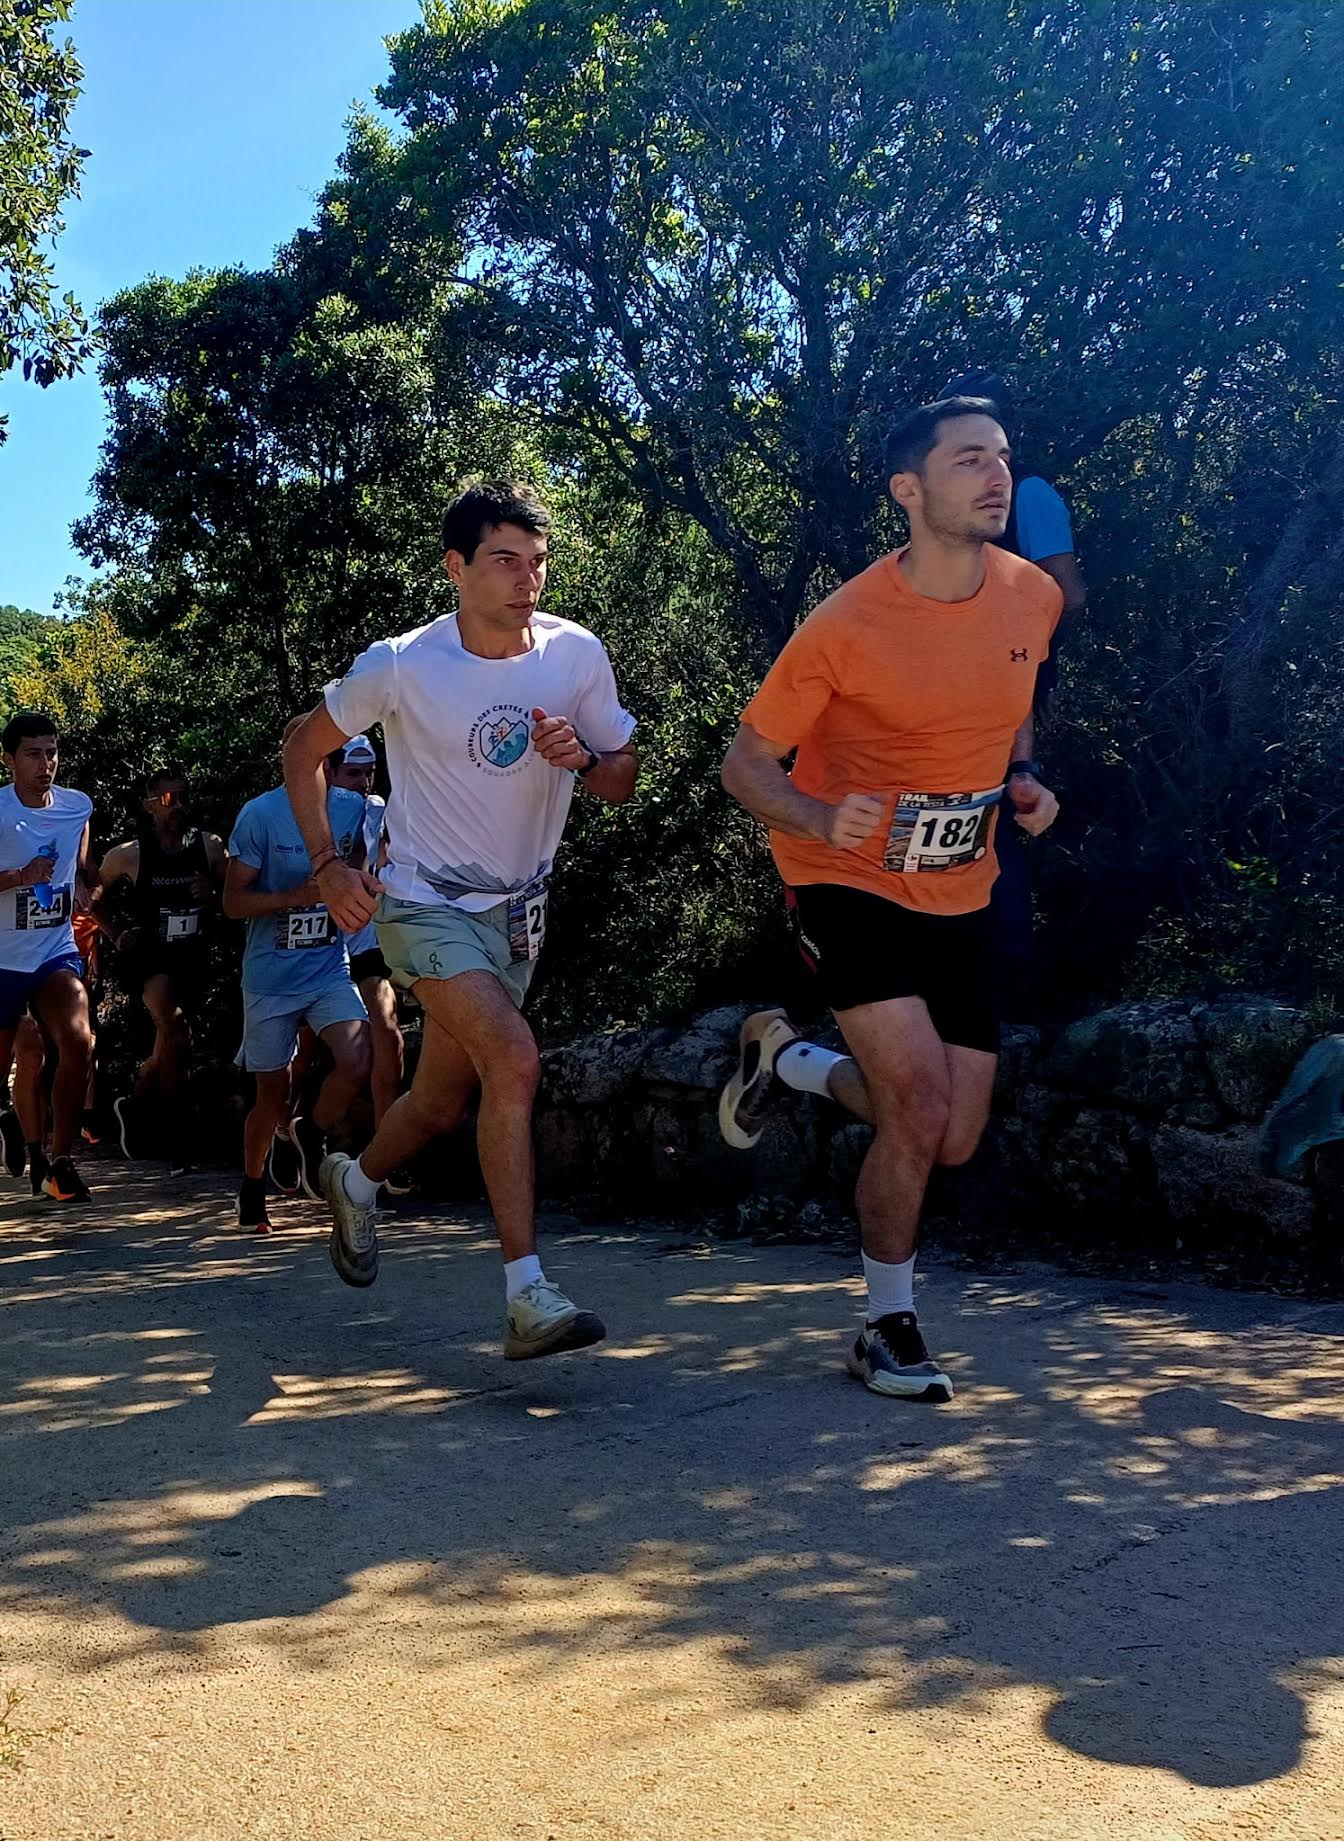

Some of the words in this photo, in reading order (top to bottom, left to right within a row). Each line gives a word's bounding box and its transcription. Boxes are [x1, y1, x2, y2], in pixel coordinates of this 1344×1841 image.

[477, 708, 491, 722] DES
[921, 814, 979, 848] 182
[180, 919, 187, 932] 1
[290, 915, 327, 936] 217
[529, 900, 547, 935] 2
